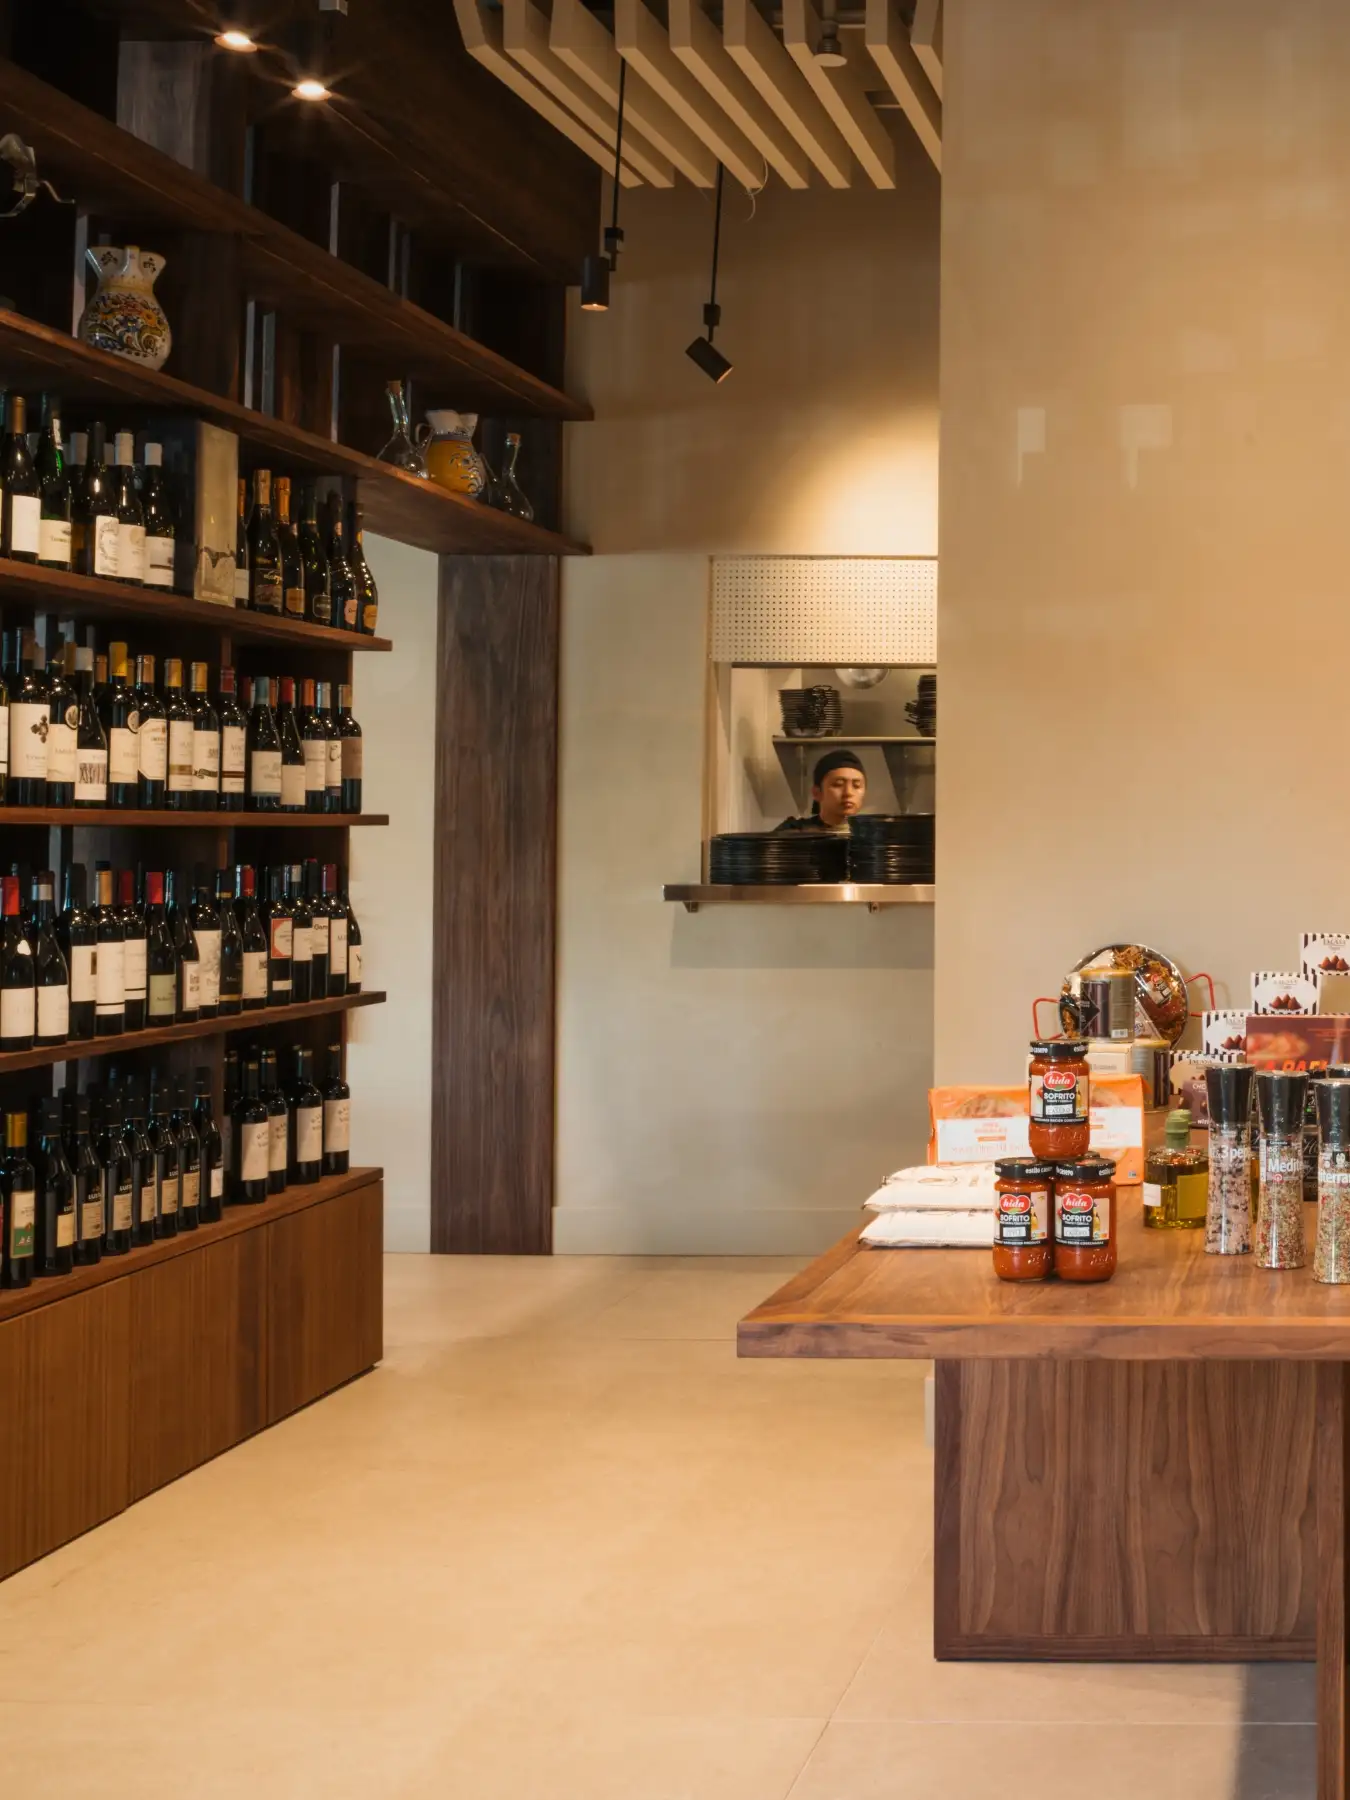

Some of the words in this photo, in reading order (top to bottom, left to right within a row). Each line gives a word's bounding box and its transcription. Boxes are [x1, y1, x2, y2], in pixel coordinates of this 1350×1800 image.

[1048, 1075, 1071, 1085] hida
[1044, 1092, 1076, 1100] SOFRITO
[1003, 1199, 1025, 1208] hida
[1065, 1198, 1088, 1207] hida
[1000, 1214, 1030, 1222] SOFRITO
[1062, 1214, 1093, 1222] SOFRITO
